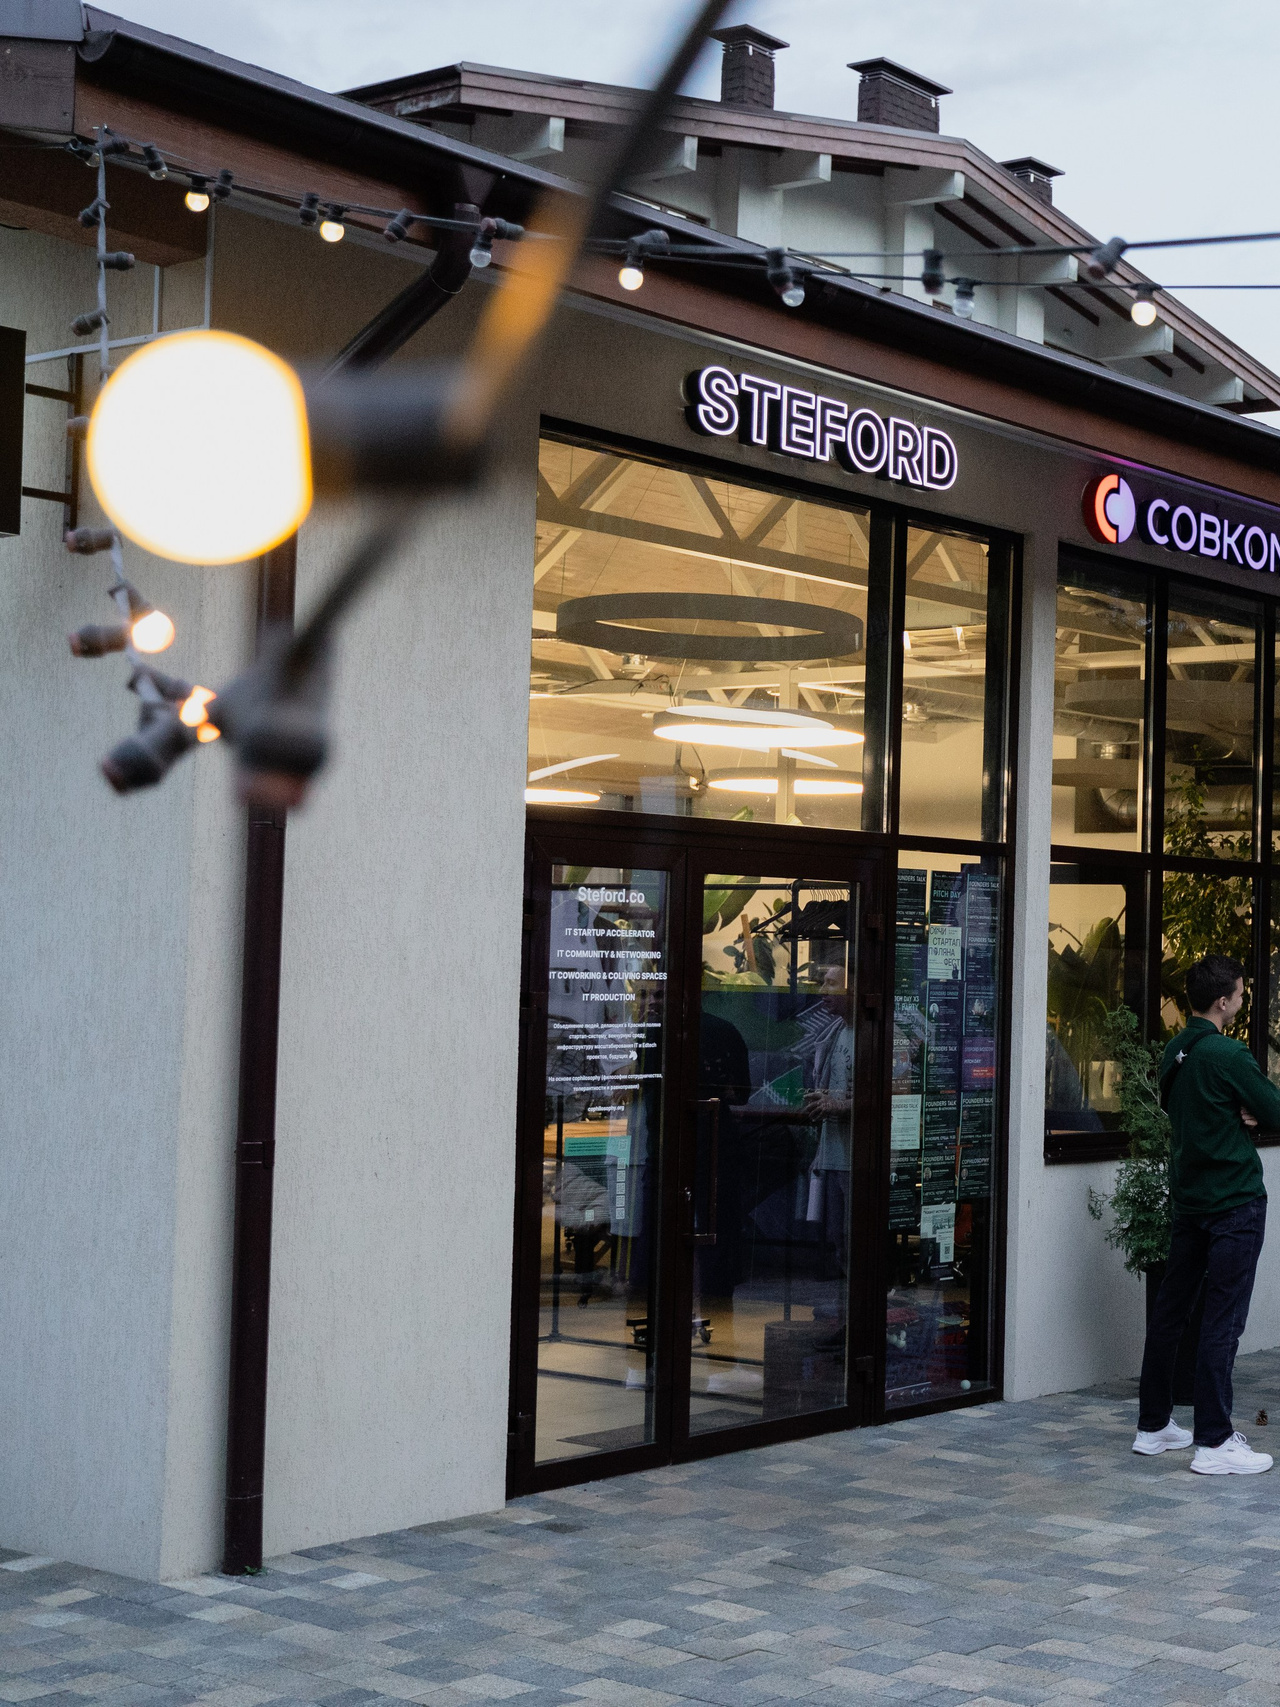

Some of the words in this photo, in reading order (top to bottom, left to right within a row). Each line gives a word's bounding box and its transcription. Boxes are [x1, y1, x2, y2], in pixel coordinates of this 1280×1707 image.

[696, 366, 958, 490] STEFORD
[578, 886, 645, 904] Steford.co
[933, 890, 948, 898] PITCH
[950, 890, 962, 898] DAY
[565, 928, 572, 936] IT
[573, 928, 606, 936] STARTUP
[606, 929, 656, 938] ACCELERATOR
[932, 937, 960, 946] СТАРТАП
[556, 949, 563, 958] IT
[565, 949, 609, 958] COMMUNITY
[616, 951, 662, 959] NETWORKING
[944, 958, 960, 966] ФЕСТ
[558, 972, 601, 980] COWORKING
[608, 972, 640, 980] COLIVING
